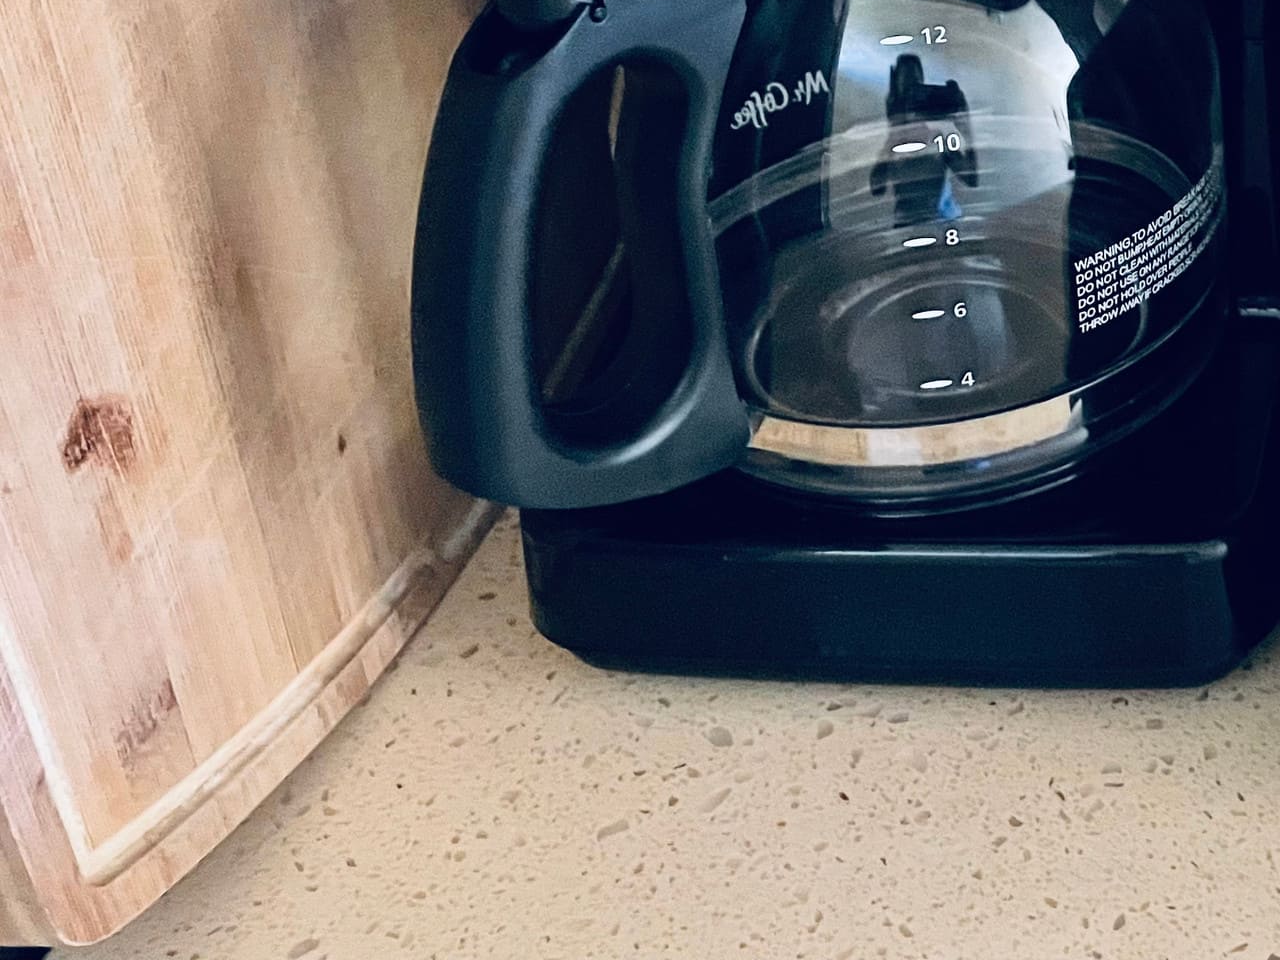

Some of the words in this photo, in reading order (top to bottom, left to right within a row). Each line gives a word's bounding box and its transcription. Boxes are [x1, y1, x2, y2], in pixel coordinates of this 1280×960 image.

[921, 26, 948, 45] 12
[933, 133, 961, 153] 10
[1147, 209, 1172, 236] AVOID
[945, 229, 960, 246] 8
[1076, 269, 1094, 285] DO
[1094, 257, 1117, 277] NOT
[1077, 282, 1095, 297] DO
[1096, 269, 1118, 289] NOT
[1119, 252, 1149, 276] CLEAN
[1078, 294, 1096, 310] DO
[1097, 281, 1119, 301] NOT
[1119, 270, 1139, 289] USE
[1139, 262, 1152, 278] ON
[1079, 307, 1096, 322] DO
[1098, 294, 1120, 313] NOT
[1120, 280, 1146, 302] HOLD
[1146, 264, 1168, 286] OVER
[953, 302, 967, 318] 6
[1079, 307, 1119, 334] THROW
[1119, 292, 1145, 315] AWAY
[961, 372, 976, 387] 4
